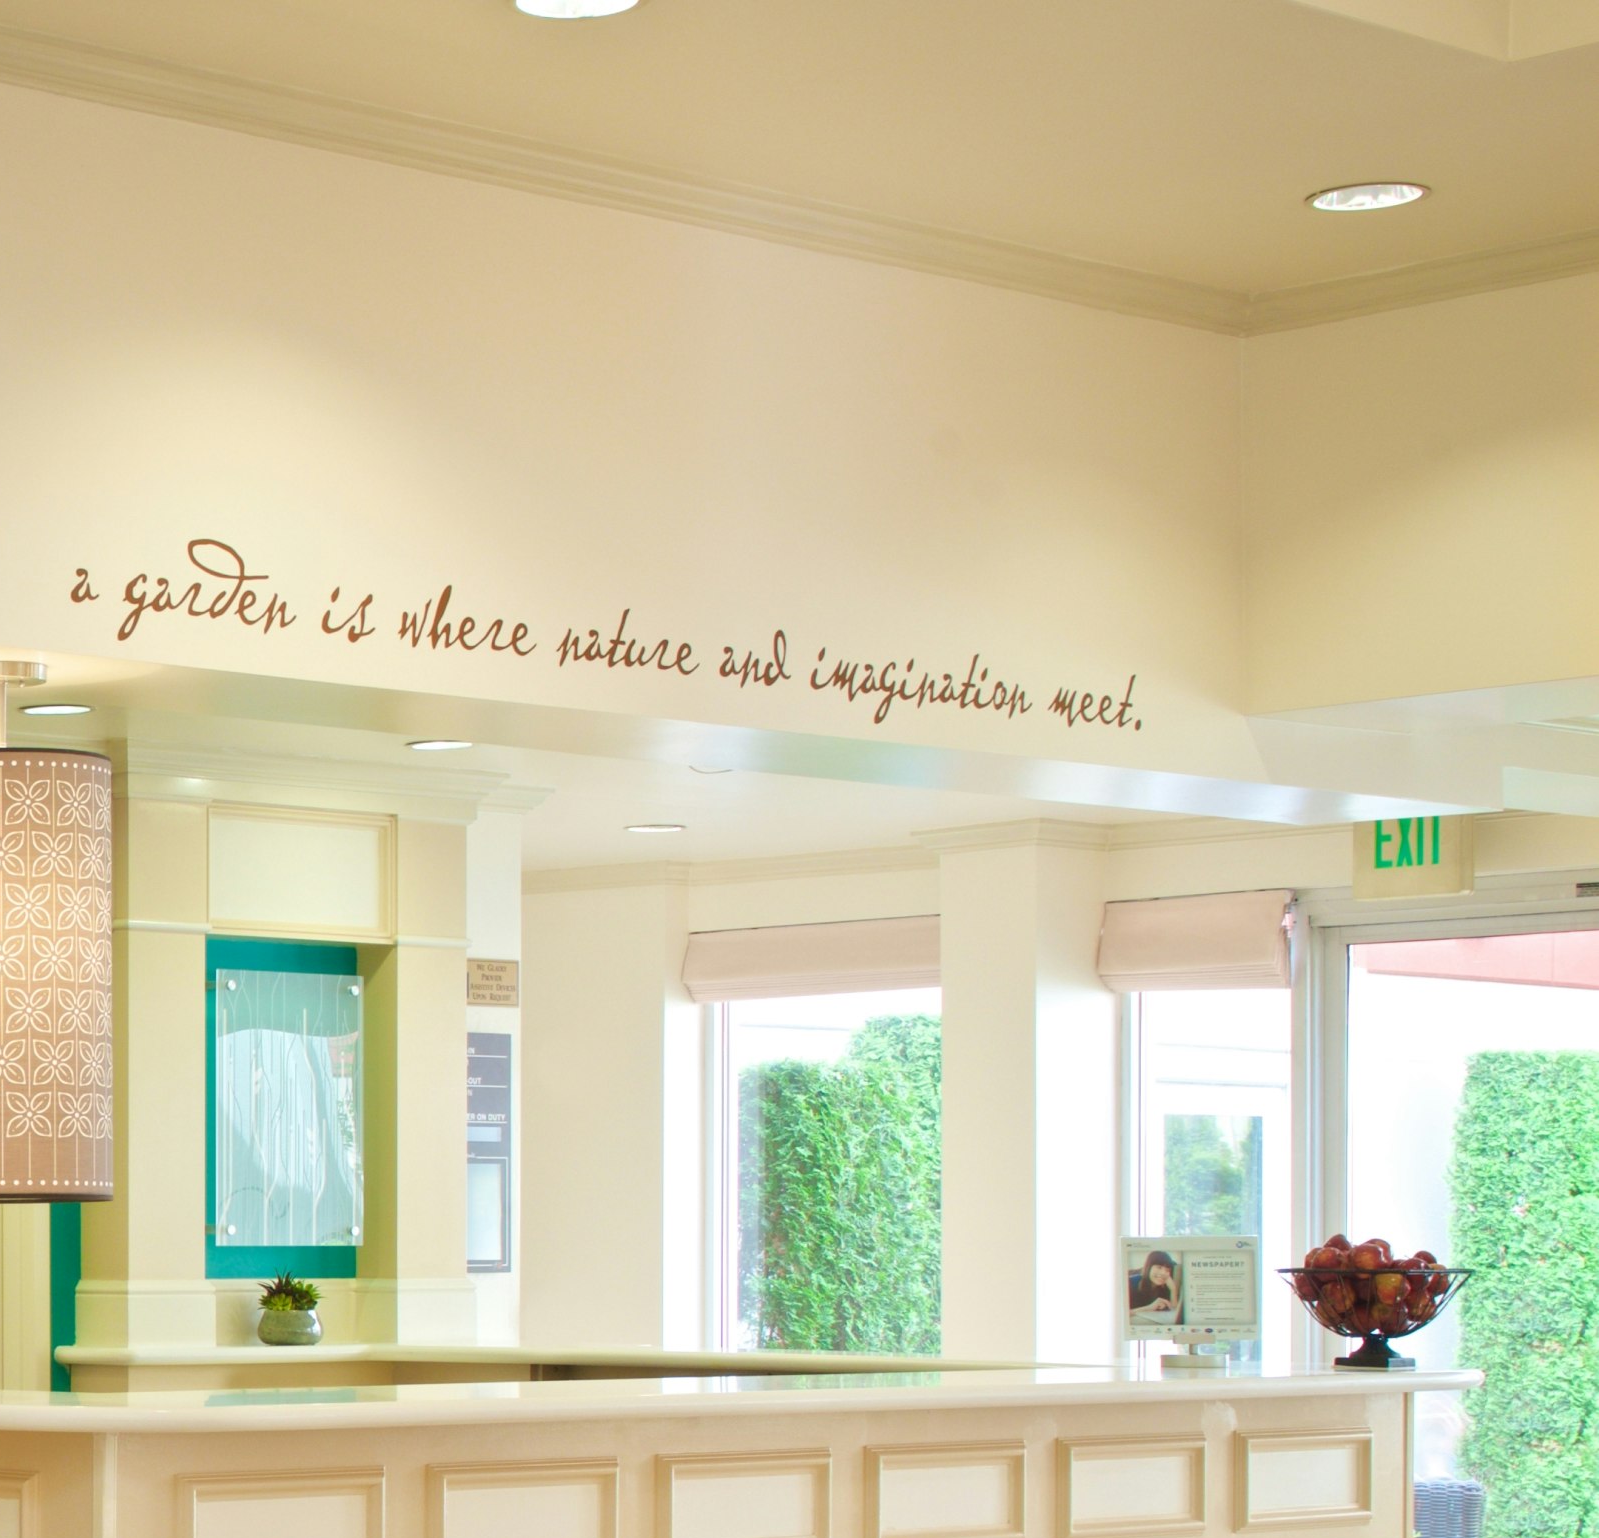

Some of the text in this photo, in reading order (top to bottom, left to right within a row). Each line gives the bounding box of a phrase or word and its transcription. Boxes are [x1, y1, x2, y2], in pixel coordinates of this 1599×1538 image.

[70, 538, 1142, 731] a garden is where nature and imagination meet.
